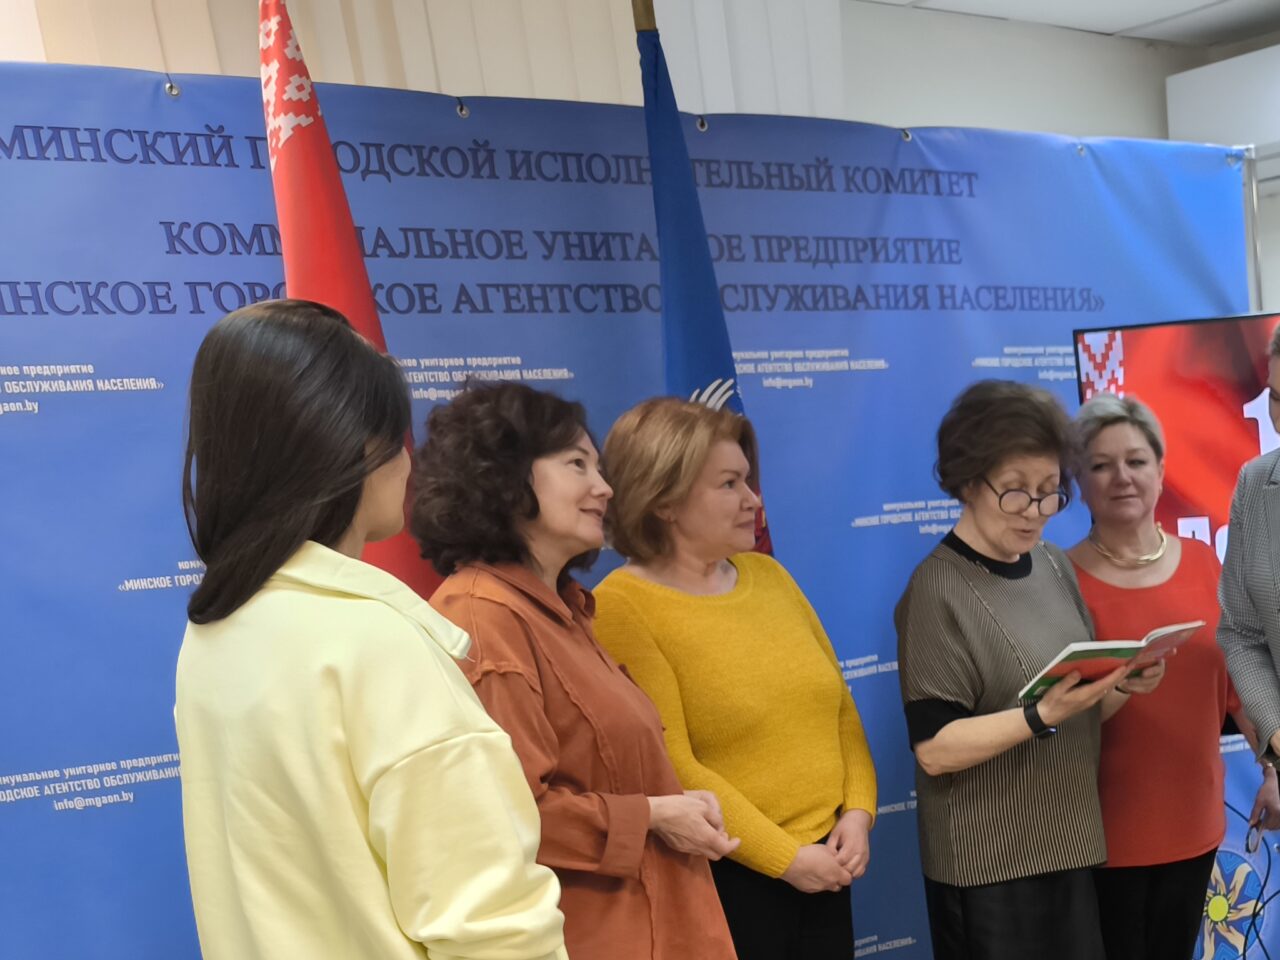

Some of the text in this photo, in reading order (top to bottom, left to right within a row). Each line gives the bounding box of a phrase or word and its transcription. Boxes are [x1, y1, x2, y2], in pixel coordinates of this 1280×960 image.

[0, 123, 979, 198] МИНСКИЙ ГОДСКОЙ ИСПОЛНТЕЛЬНЫЙ КОМИТЕТ
[159, 221, 963, 269] КОМАЛЬНОЕ УНИТАОЕ ПРЕДПРИЯТИЕ
[719, 283, 931, 313] СЛУЖИВАНИЯ
[936, 283, 1105, 313] НАСЕЛЕНИЯ»
[22, 363, 95, 378] предприятие
[4, 377, 165, 394] ОБСЛУЖИВАНИЯ НАСЕЛЕНИЯ»
[118, 575, 173, 592] «МИНСКОЕ
[63, 761, 118, 779] унитарное
[120, 752, 180, 769] предприяти
[44, 778, 101, 797] АГЕНТСТВО
[53, 790, 134, 811] info@mgaon.by
